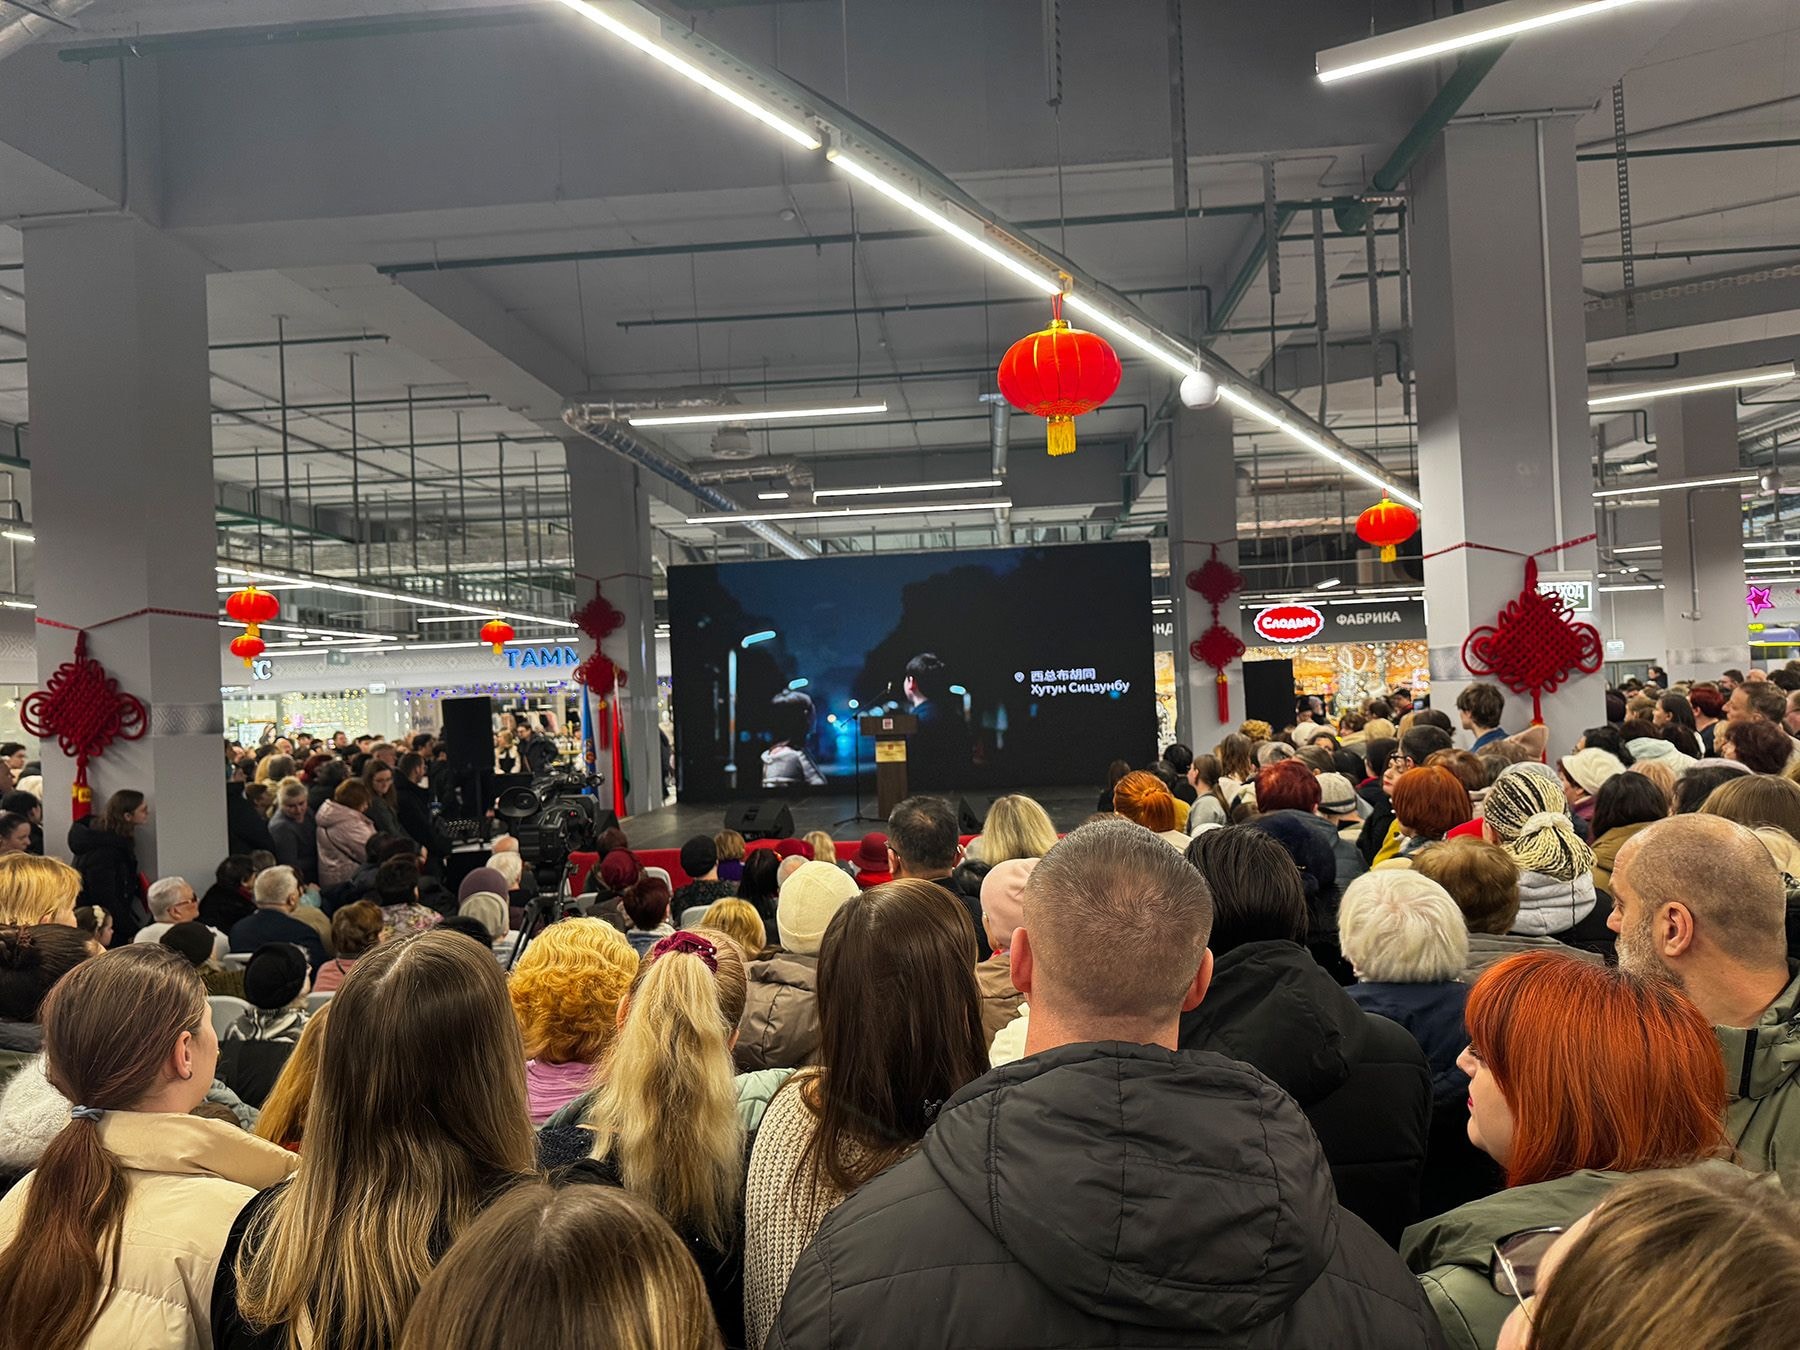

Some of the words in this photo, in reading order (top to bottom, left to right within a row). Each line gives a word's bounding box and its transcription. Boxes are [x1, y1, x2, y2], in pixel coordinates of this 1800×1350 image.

[1335, 611, 1402, 626] ФАБРИКА
[1030, 667, 1097, 682] 西总布胡同
[1030, 682, 1067, 697] Хутун
[1068, 679, 1131, 695] Сицзунбу
